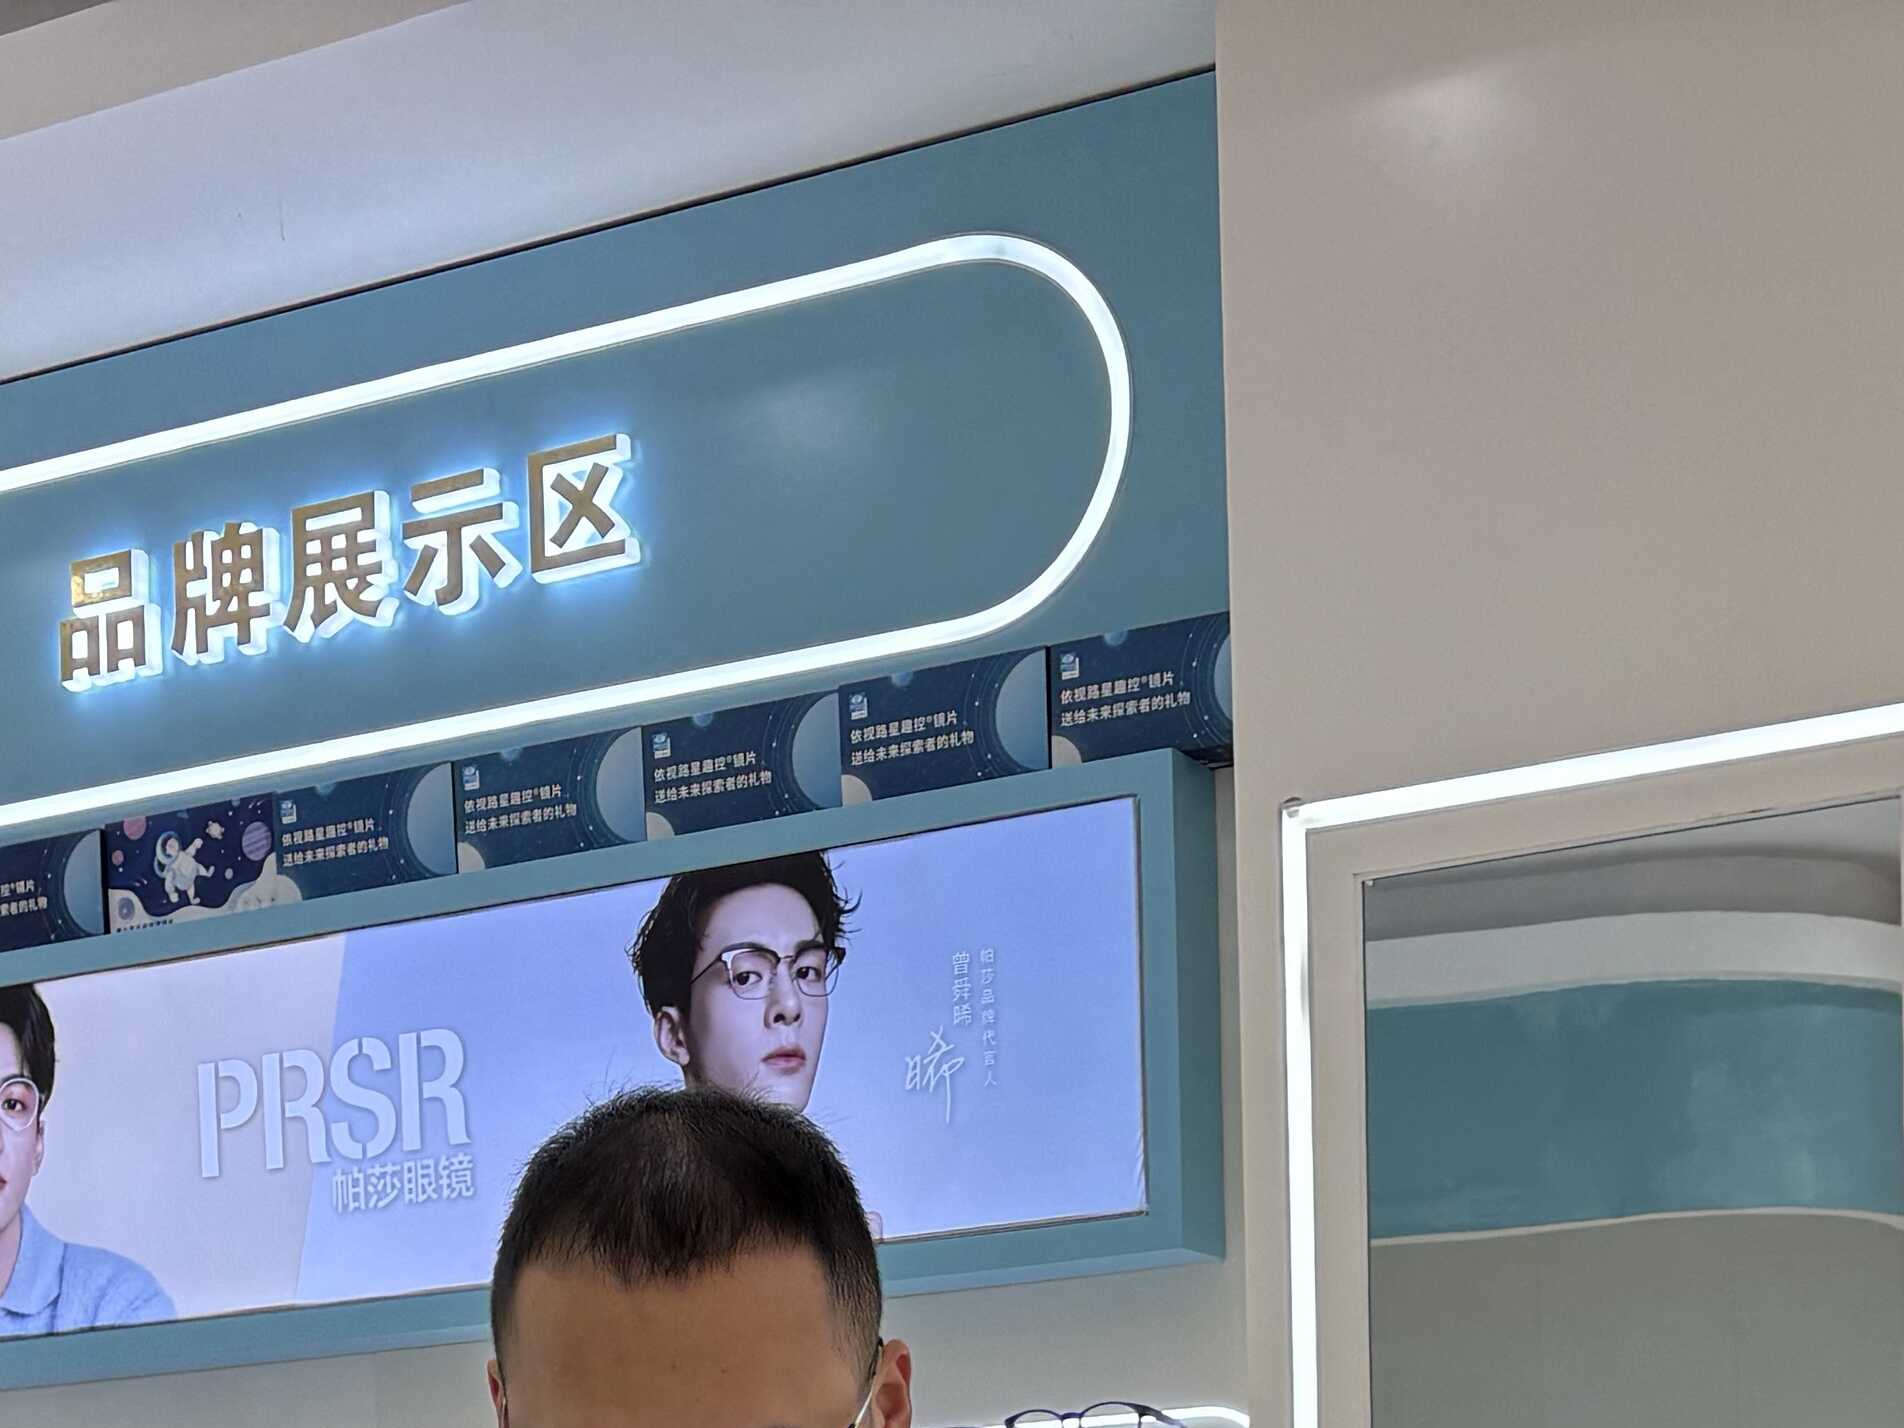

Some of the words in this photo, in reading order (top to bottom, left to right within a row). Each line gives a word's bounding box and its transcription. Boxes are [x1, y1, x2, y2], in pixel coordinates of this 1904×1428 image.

[59, 433, 641, 692] 品牌展示区
[197, 1028, 472, 1178] PRSR
[332, 1152, 475, 1214] 帕莎眼镜
